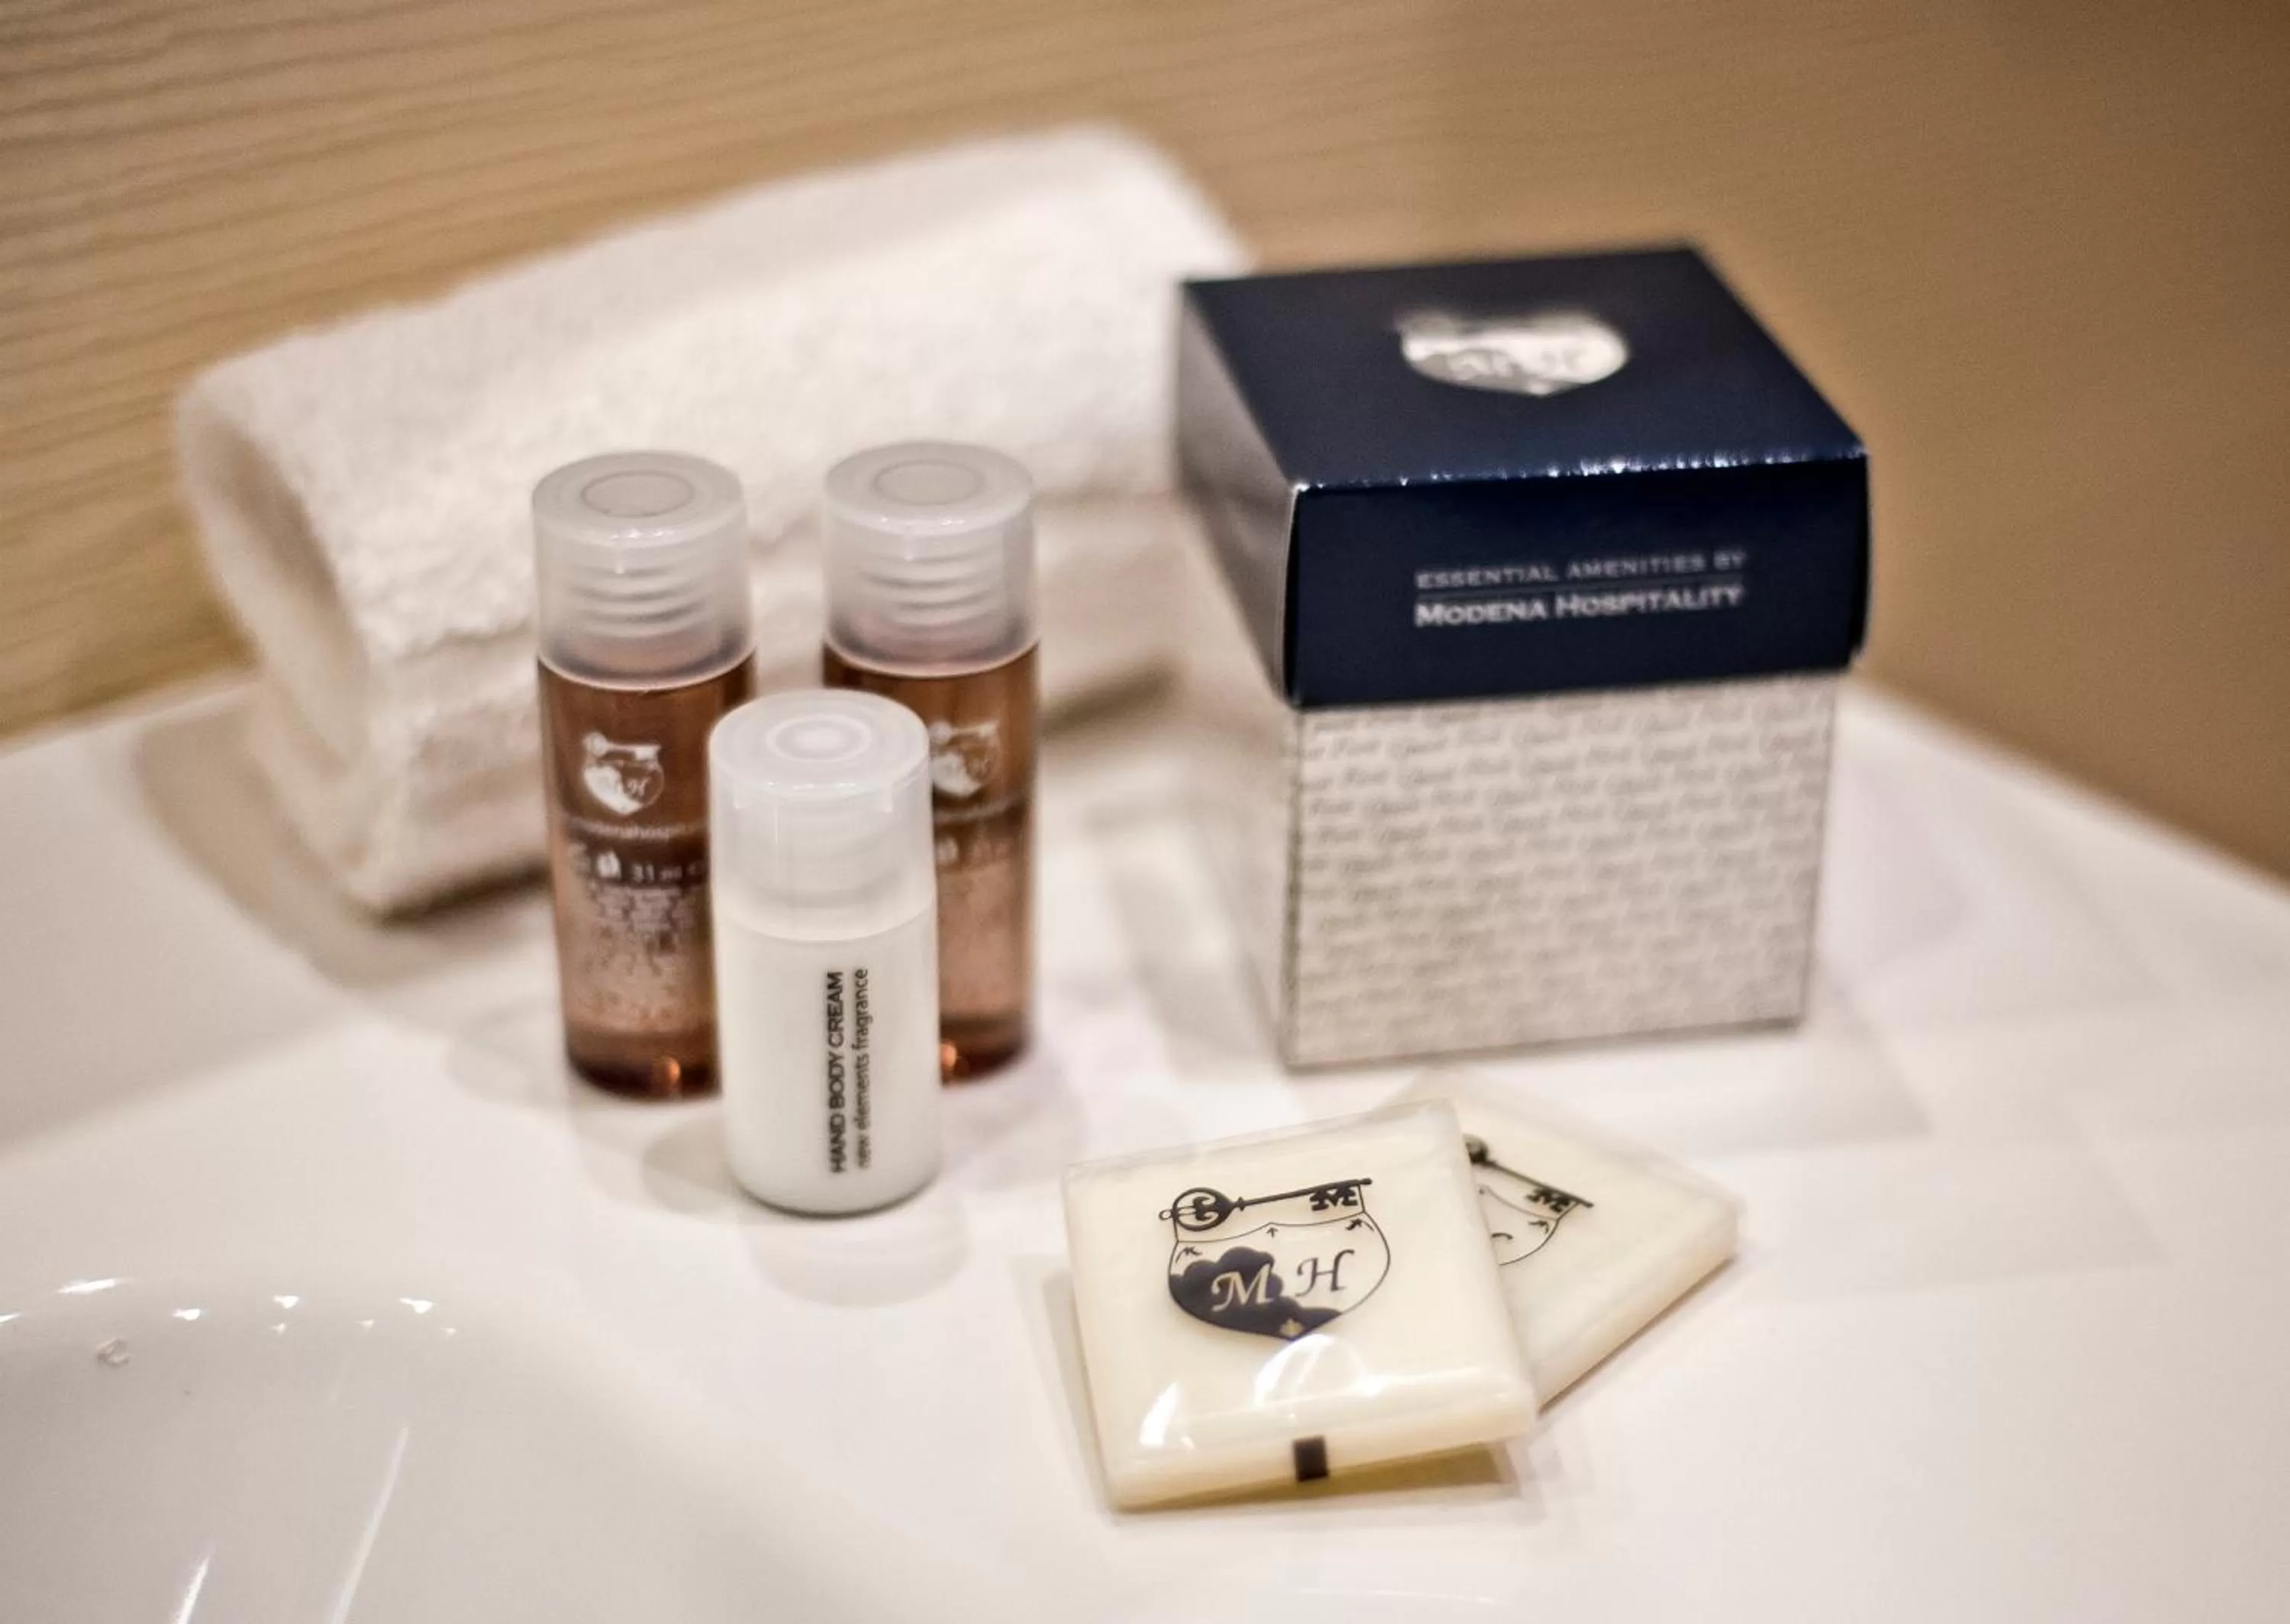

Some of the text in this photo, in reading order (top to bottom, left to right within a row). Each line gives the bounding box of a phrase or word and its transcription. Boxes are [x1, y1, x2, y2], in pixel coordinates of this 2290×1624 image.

[1415, 548, 1747, 590] ESSENTIAL AMENITIES BY
[1415, 599, 1549, 628] MODENA
[852, 968, 874, 1051] fragrance
[827, 971, 847, 1173] HAND BODY CREAM
[853, 1052, 870, 1131] elements
